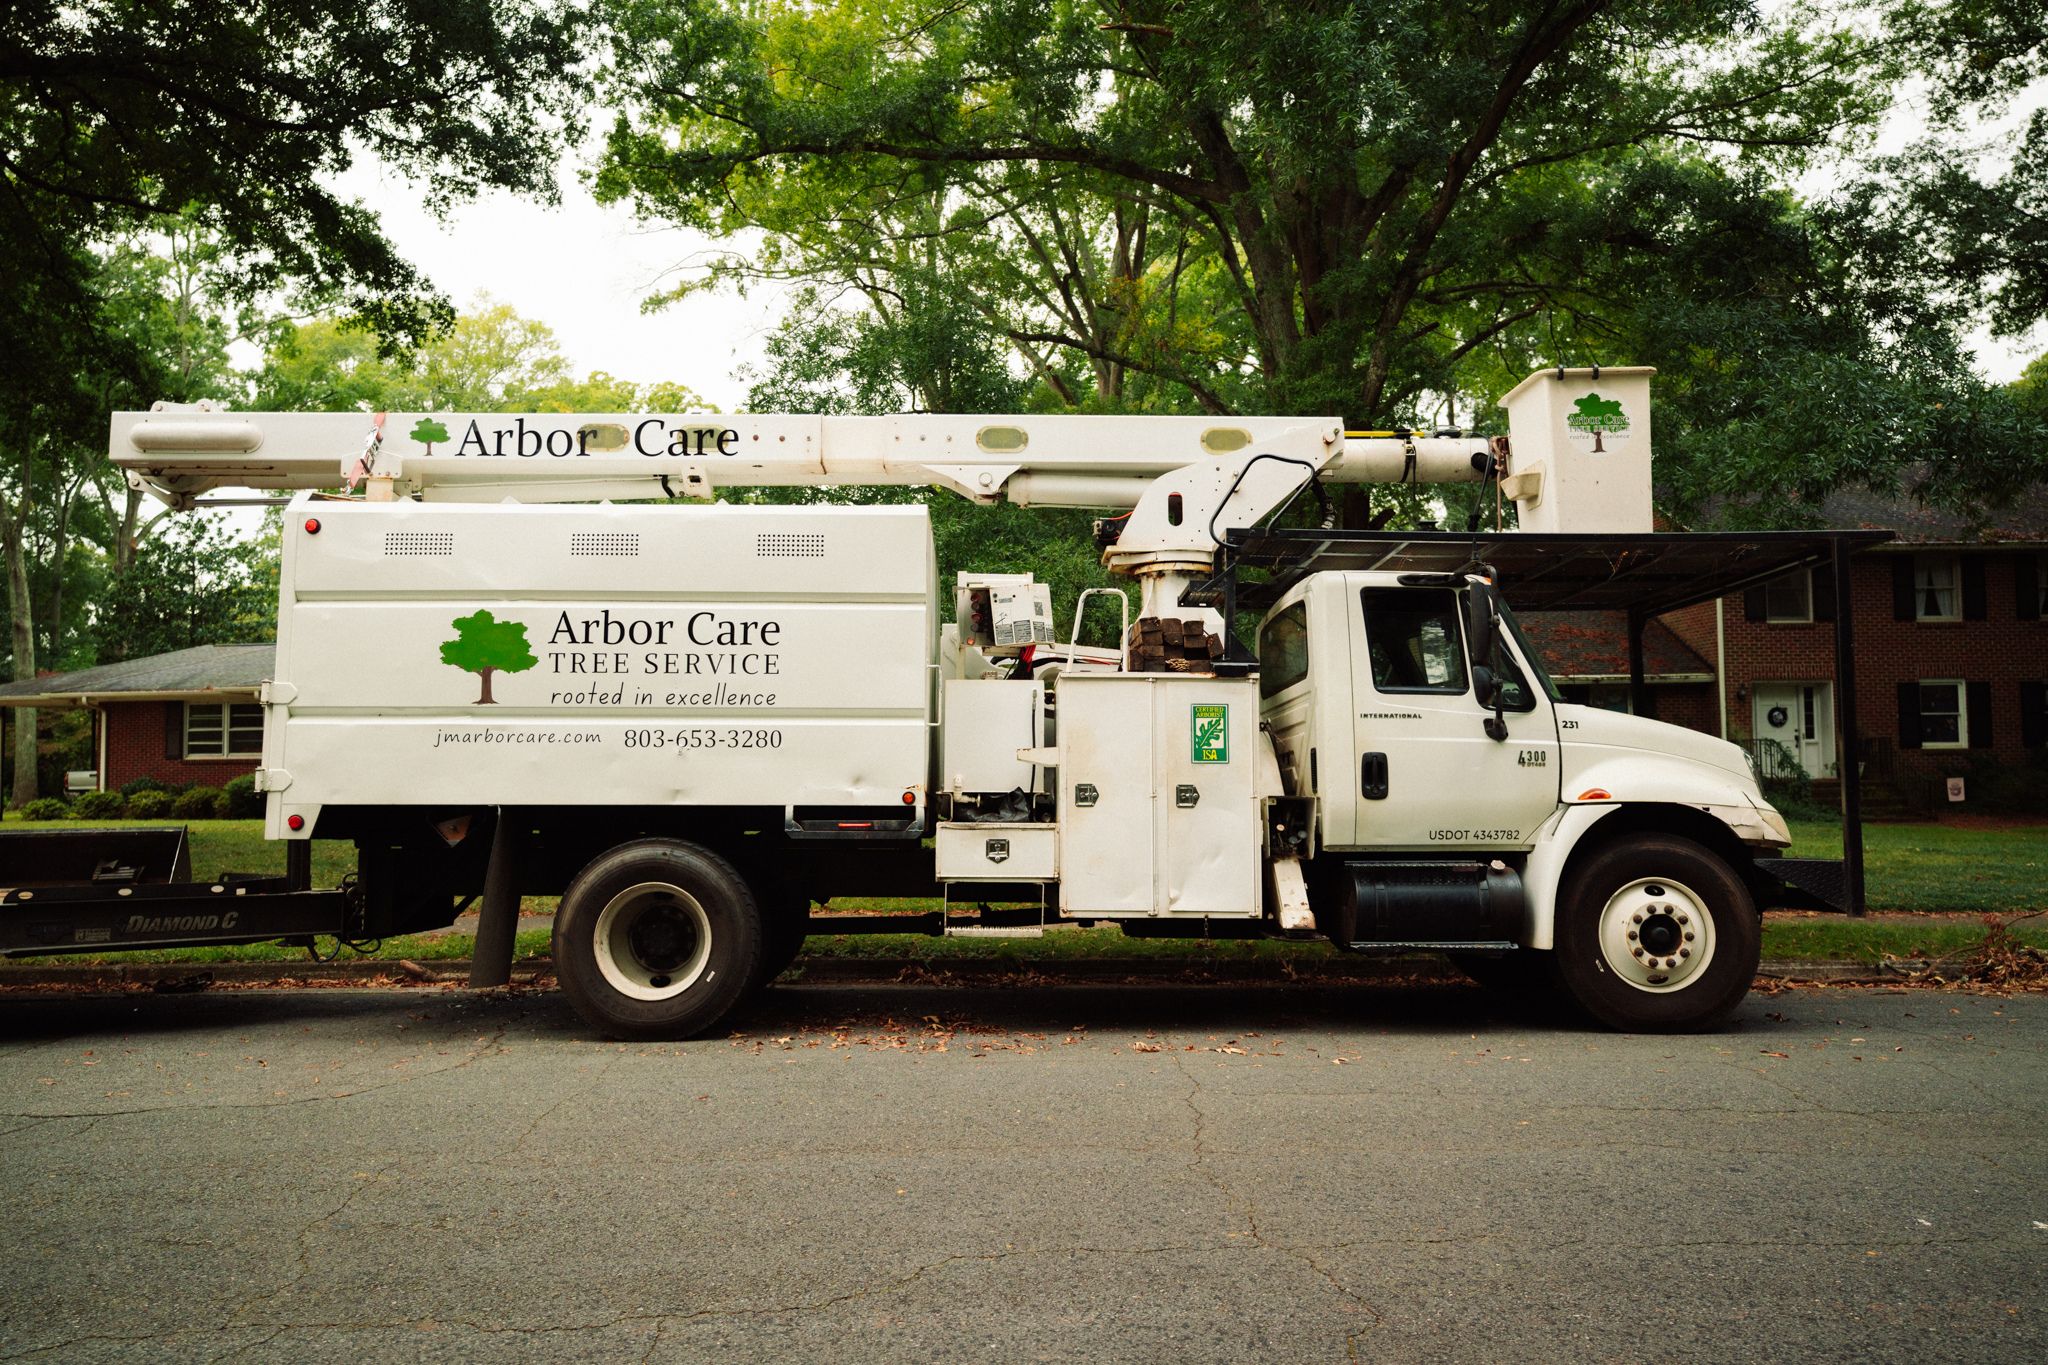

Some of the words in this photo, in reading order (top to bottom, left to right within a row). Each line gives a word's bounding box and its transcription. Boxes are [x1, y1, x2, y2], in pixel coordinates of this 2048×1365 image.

[1569, 414, 1601, 425] Arbor
[1604, 413, 1630, 425] Care
[455, 418, 598, 457] Arbor
[634, 419, 740, 457] Care
[547, 610, 674, 646] Arbor
[687, 612, 781, 647] Care
[548, 652, 630, 674] TREE
[644, 652, 780, 675] SERVICE
[550, 681, 624, 705] rooted
[634, 686, 653, 706] in
[665, 682, 776, 706] excellence
[1562, 720, 1579, 730] 231
[433, 728, 602, 748] jmarborcare.com
[624, 729, 782, 749] 803-653-3280
[1202, 749, 1217, 760] ISA
[1518, 750, 1546, 765] 4300
[1429, 830, 1470, 841] USDOT
[1473, 829, 1520, 841] 4343782
[222, 911, 239, 929] C
